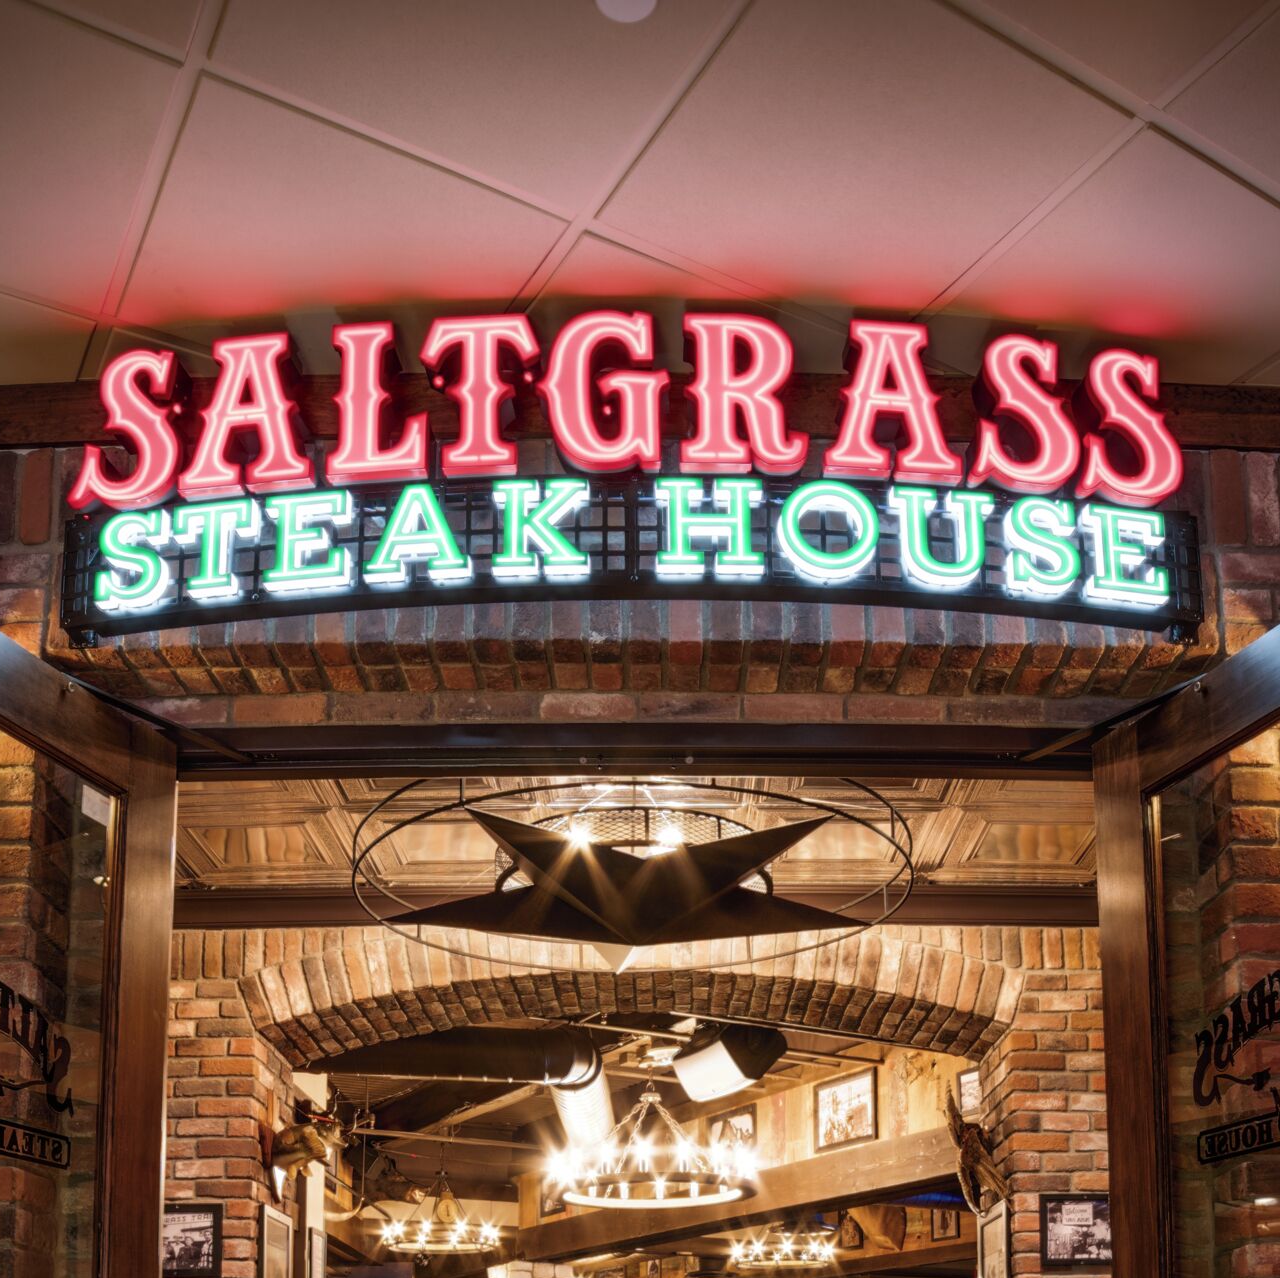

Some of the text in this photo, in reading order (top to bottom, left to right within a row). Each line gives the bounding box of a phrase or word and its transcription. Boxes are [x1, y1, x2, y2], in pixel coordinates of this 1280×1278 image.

[68, 310, 1183, 507] SALTGRASS
[95, 478, 1170, 611] STEAK HOUSE
